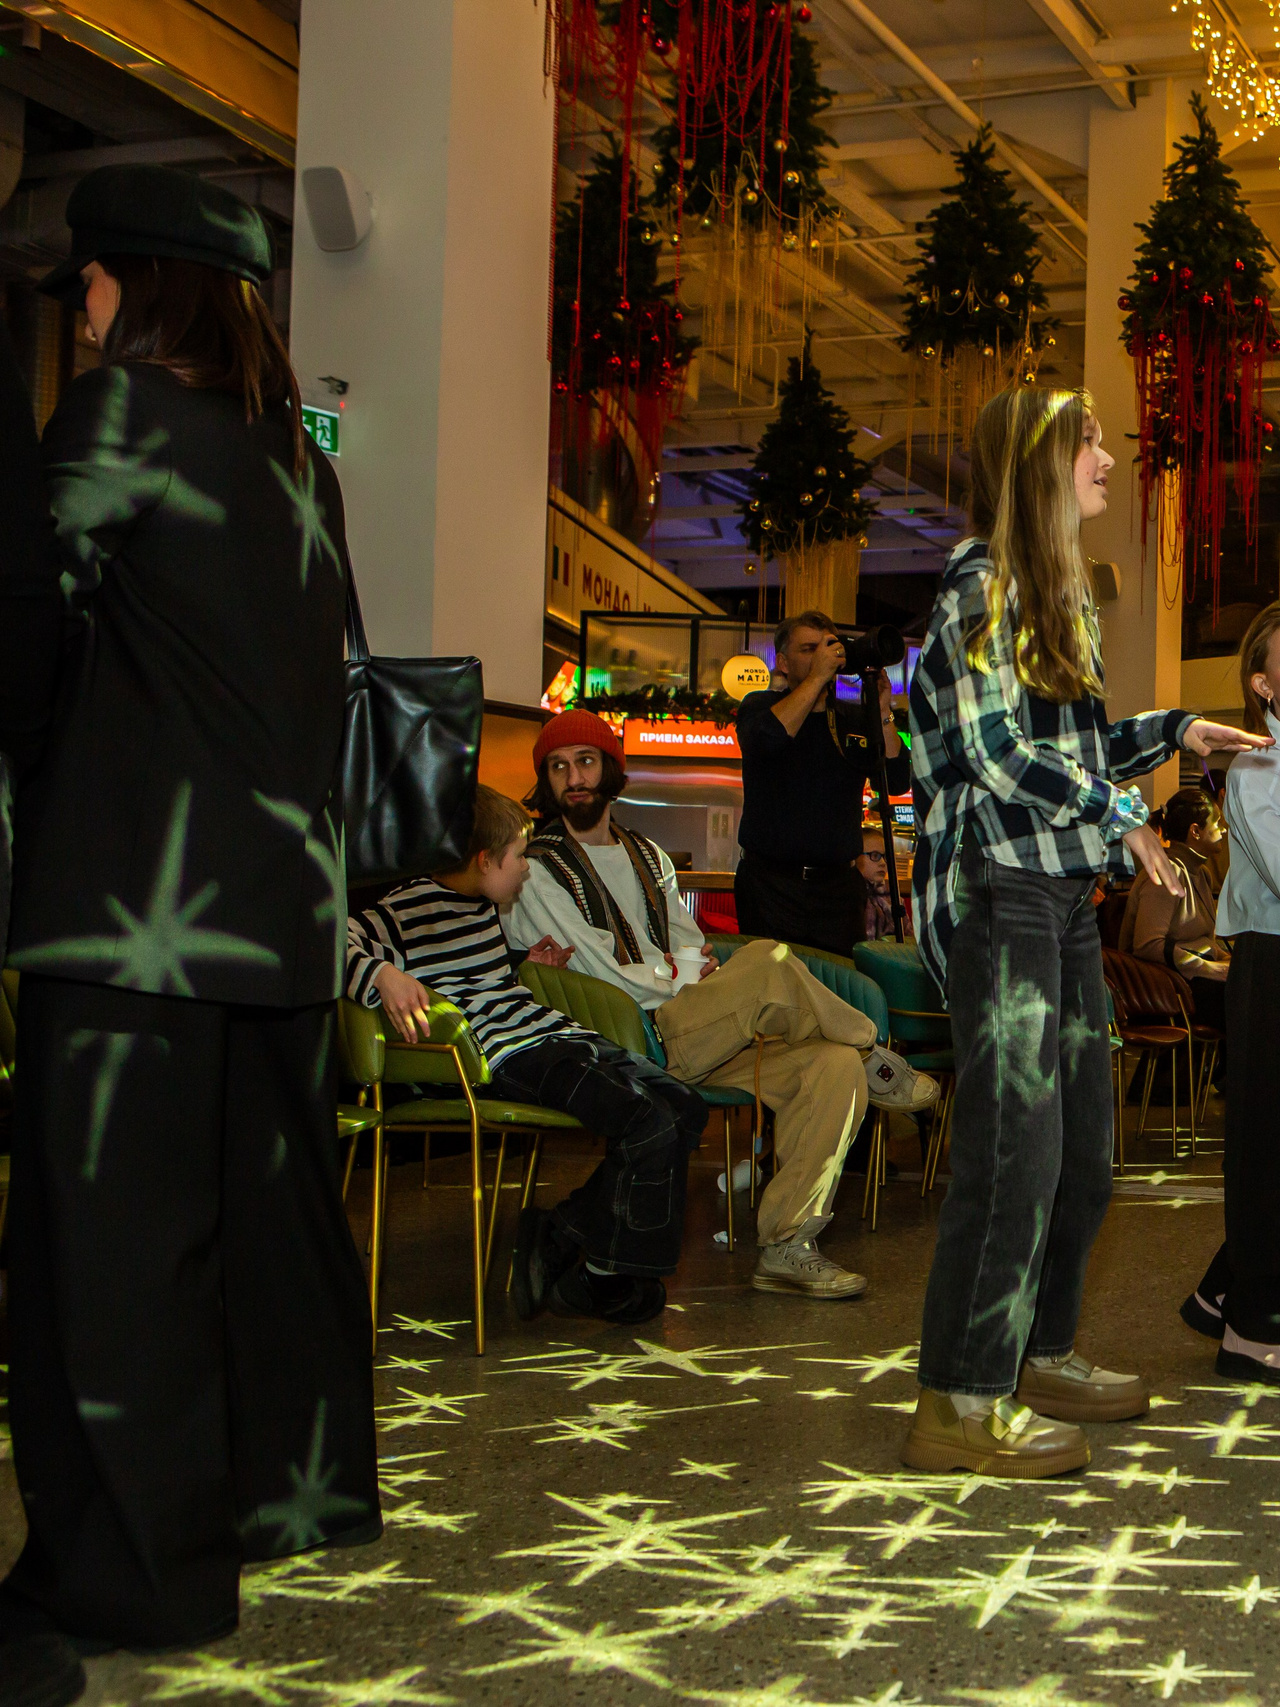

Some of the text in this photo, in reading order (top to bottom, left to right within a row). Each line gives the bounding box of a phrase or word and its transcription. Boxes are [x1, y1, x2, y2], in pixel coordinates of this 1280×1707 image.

[582, 563, 631, 612] МОНДО
[639, 732, 734, 745] ПРИЕМ ЗАКАЗА
